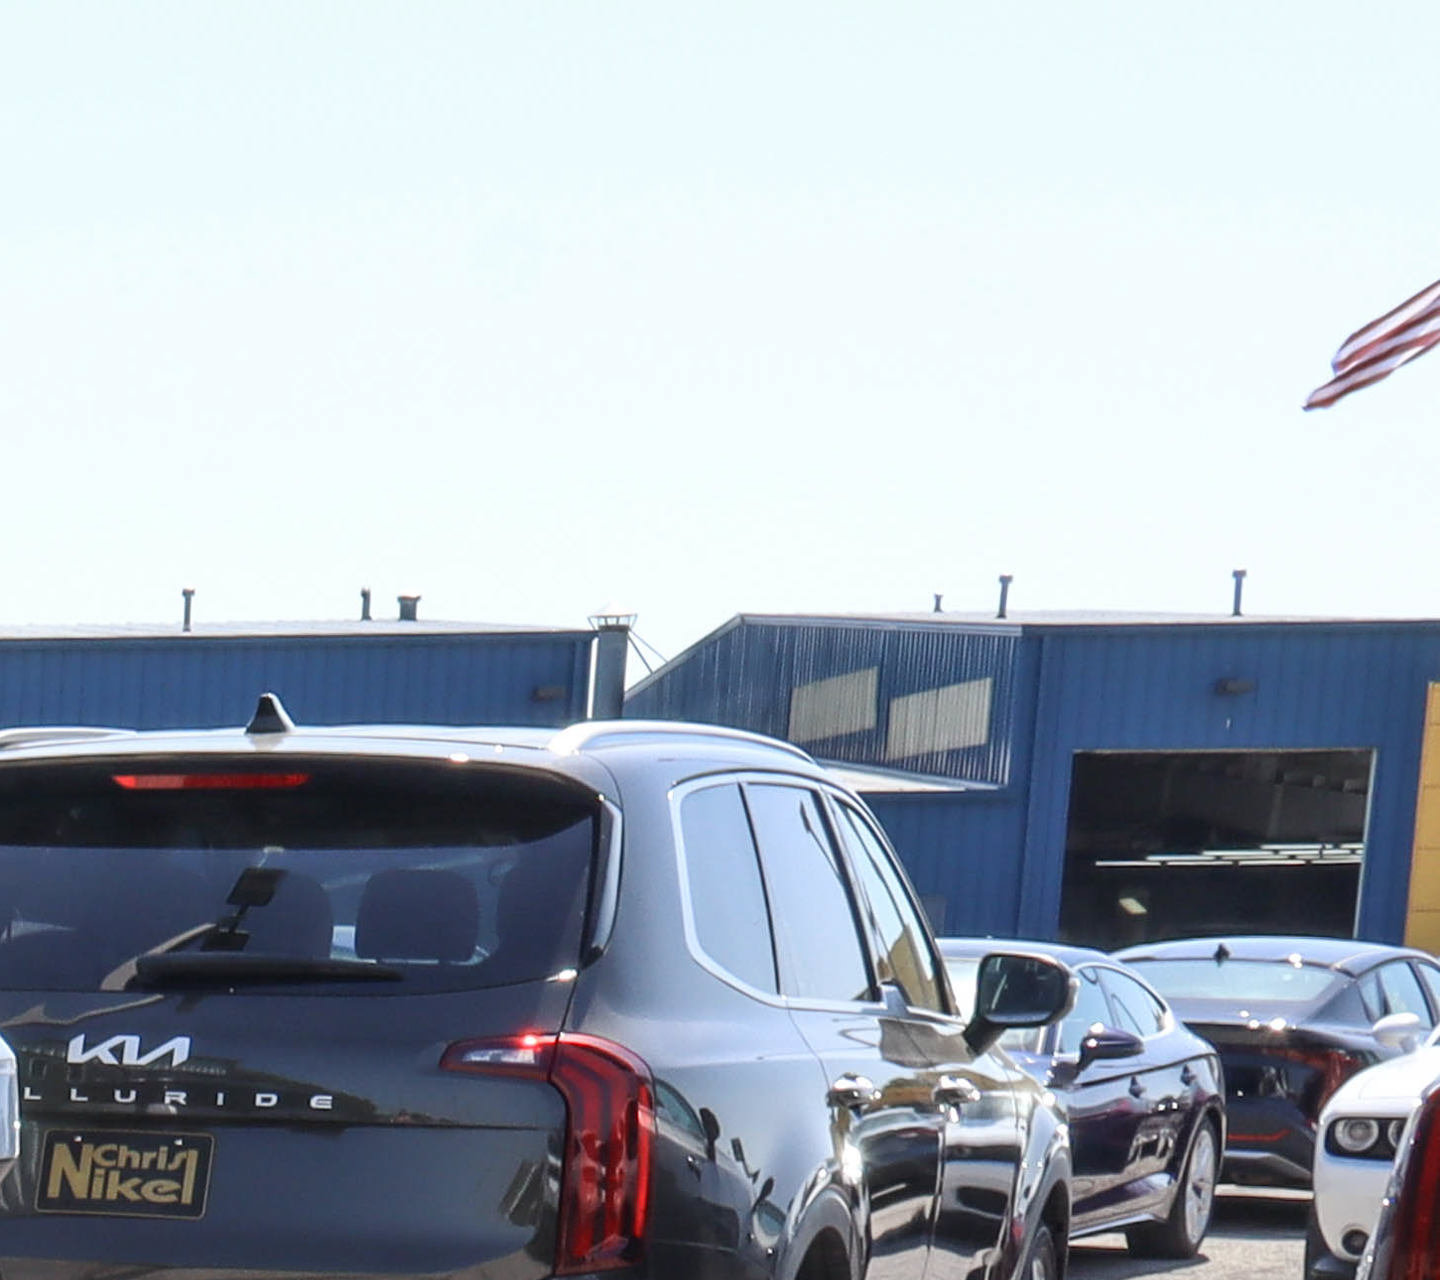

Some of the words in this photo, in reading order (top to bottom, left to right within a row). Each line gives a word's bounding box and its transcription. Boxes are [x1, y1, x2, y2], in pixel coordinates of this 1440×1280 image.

[23, 1086, 333, 1110] LLURIDE
[92, 1143, 190, 1172] Chris
[46, 1143, 199, 1205] Nikel
